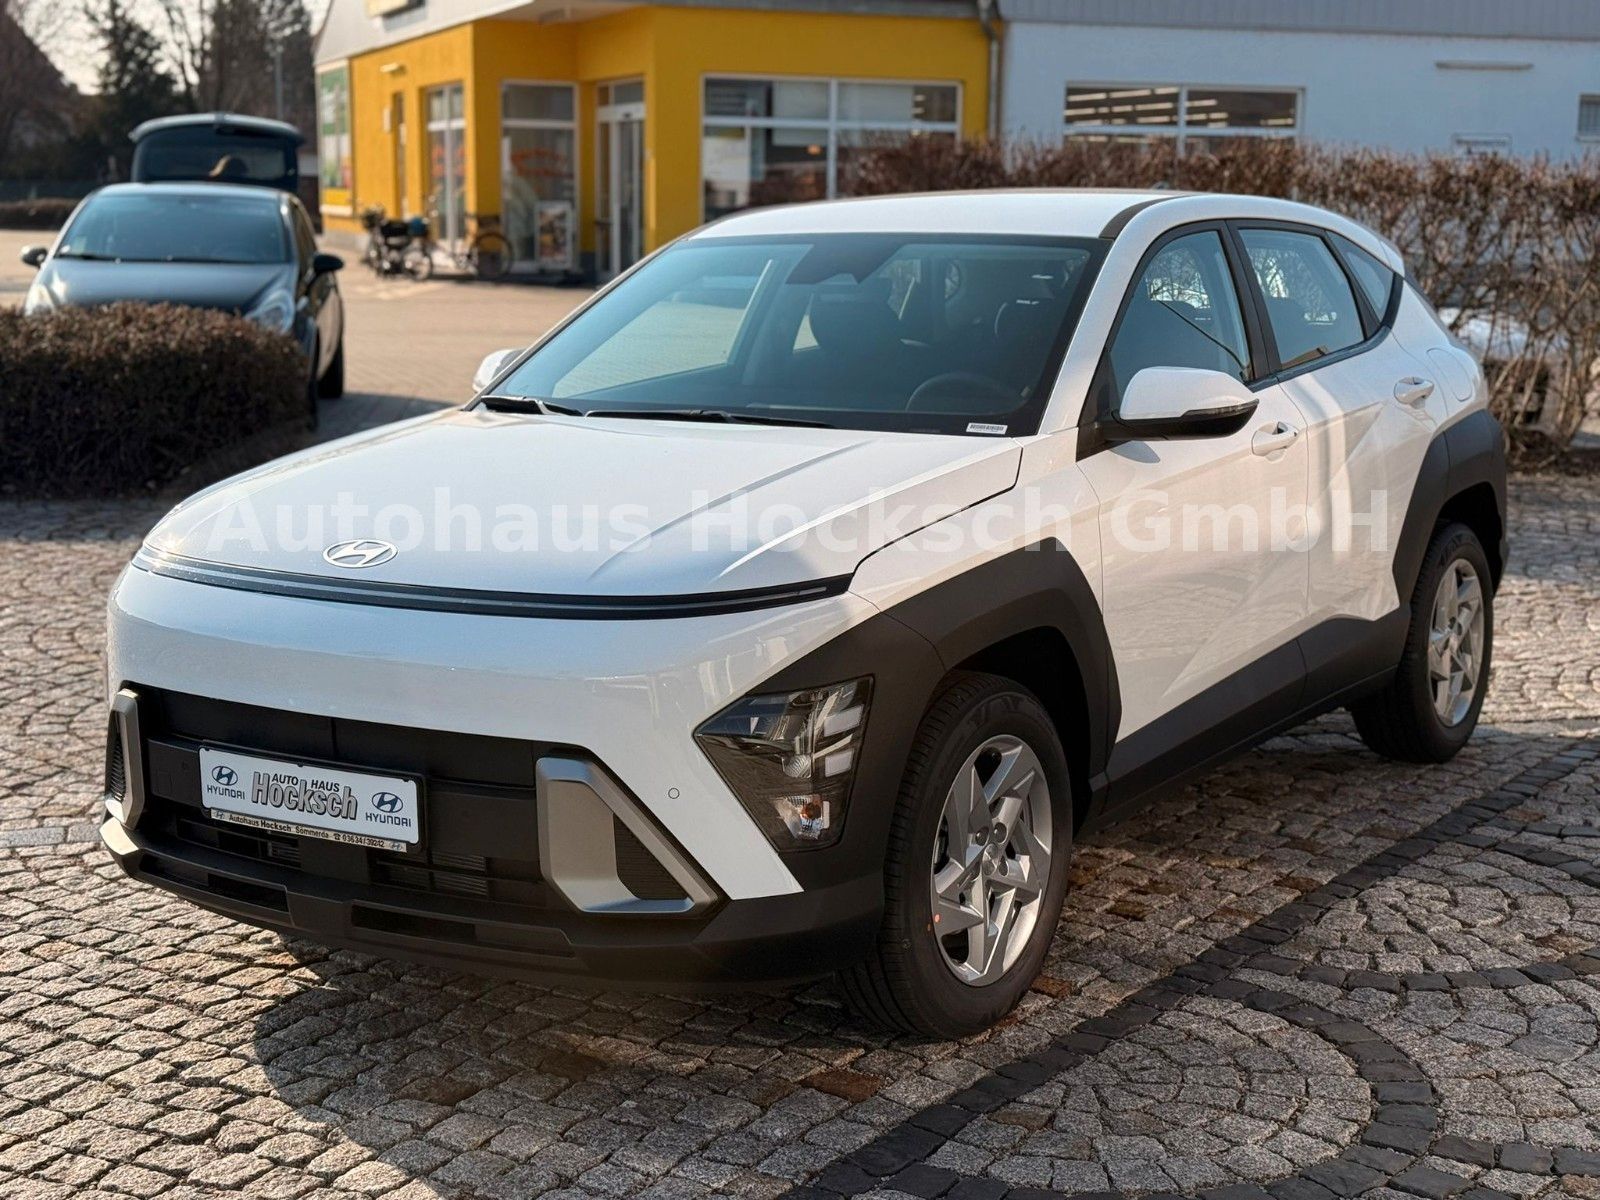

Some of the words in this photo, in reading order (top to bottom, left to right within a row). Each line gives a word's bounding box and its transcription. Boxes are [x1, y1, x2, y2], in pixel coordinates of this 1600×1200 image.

[206, 784, 245, 800] HYUNDAI
[271, 773, 299, 786] AUTO
[311, 779, 340, 793] HAUS
[251, 771, 358, 820] Hocksch
[228, 814, 260, 827] Autohaus
[260, 820, 292, 832] Hocksch
[365, 812, 411, 828] HYUNDAI
